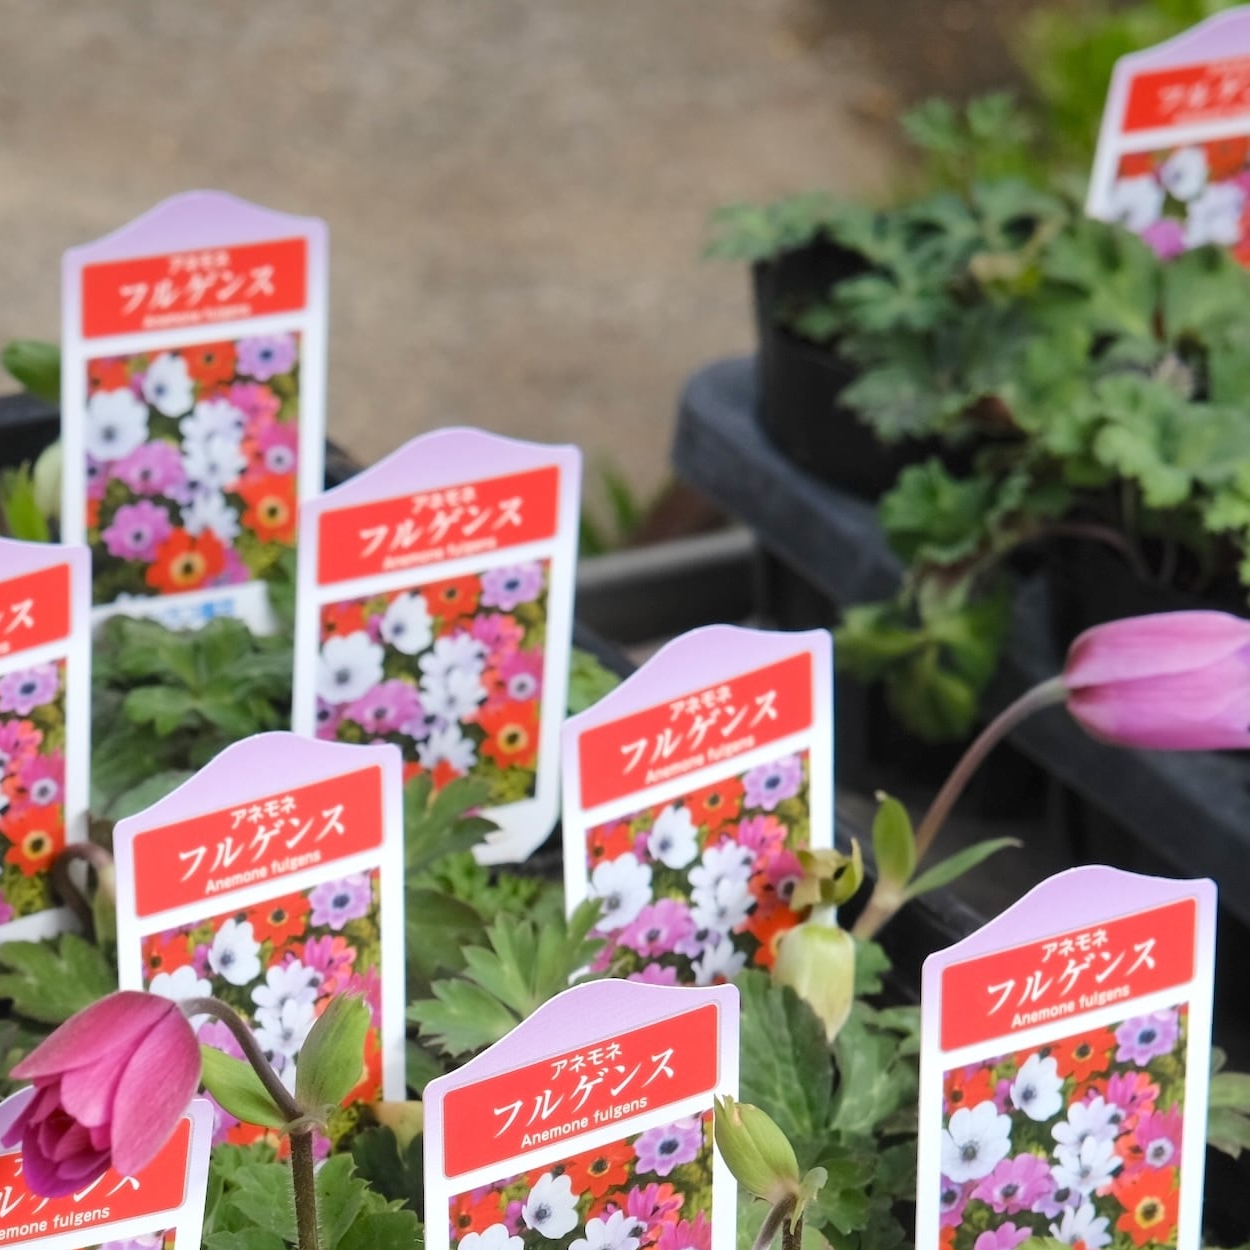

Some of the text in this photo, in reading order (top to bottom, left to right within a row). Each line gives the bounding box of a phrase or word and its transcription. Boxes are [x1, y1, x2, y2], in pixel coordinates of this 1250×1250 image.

[361, 497, 522, 557] フルゲンス
[621, 690, 777, 775] フルゲンス
[230, 794, 297, 830] アネモネ
[179, 804, 345, 882] フルゲンス
[205, 850, 321, 895] Anemone fulgens
[1041, 928, 1108, 963] アネモネ
[987, 938, 1156, 1016] フルゲンス
[1011, 985, 1130, 1029] Anemone fulgens
[550, 1041, 623, 1081] アネモネ
[493, 1047, 675, 1138] フルゲンス
[520, 1096, 648, 1150] Anemone fulgens
[53, 1206, 111, 1229] fulgens
